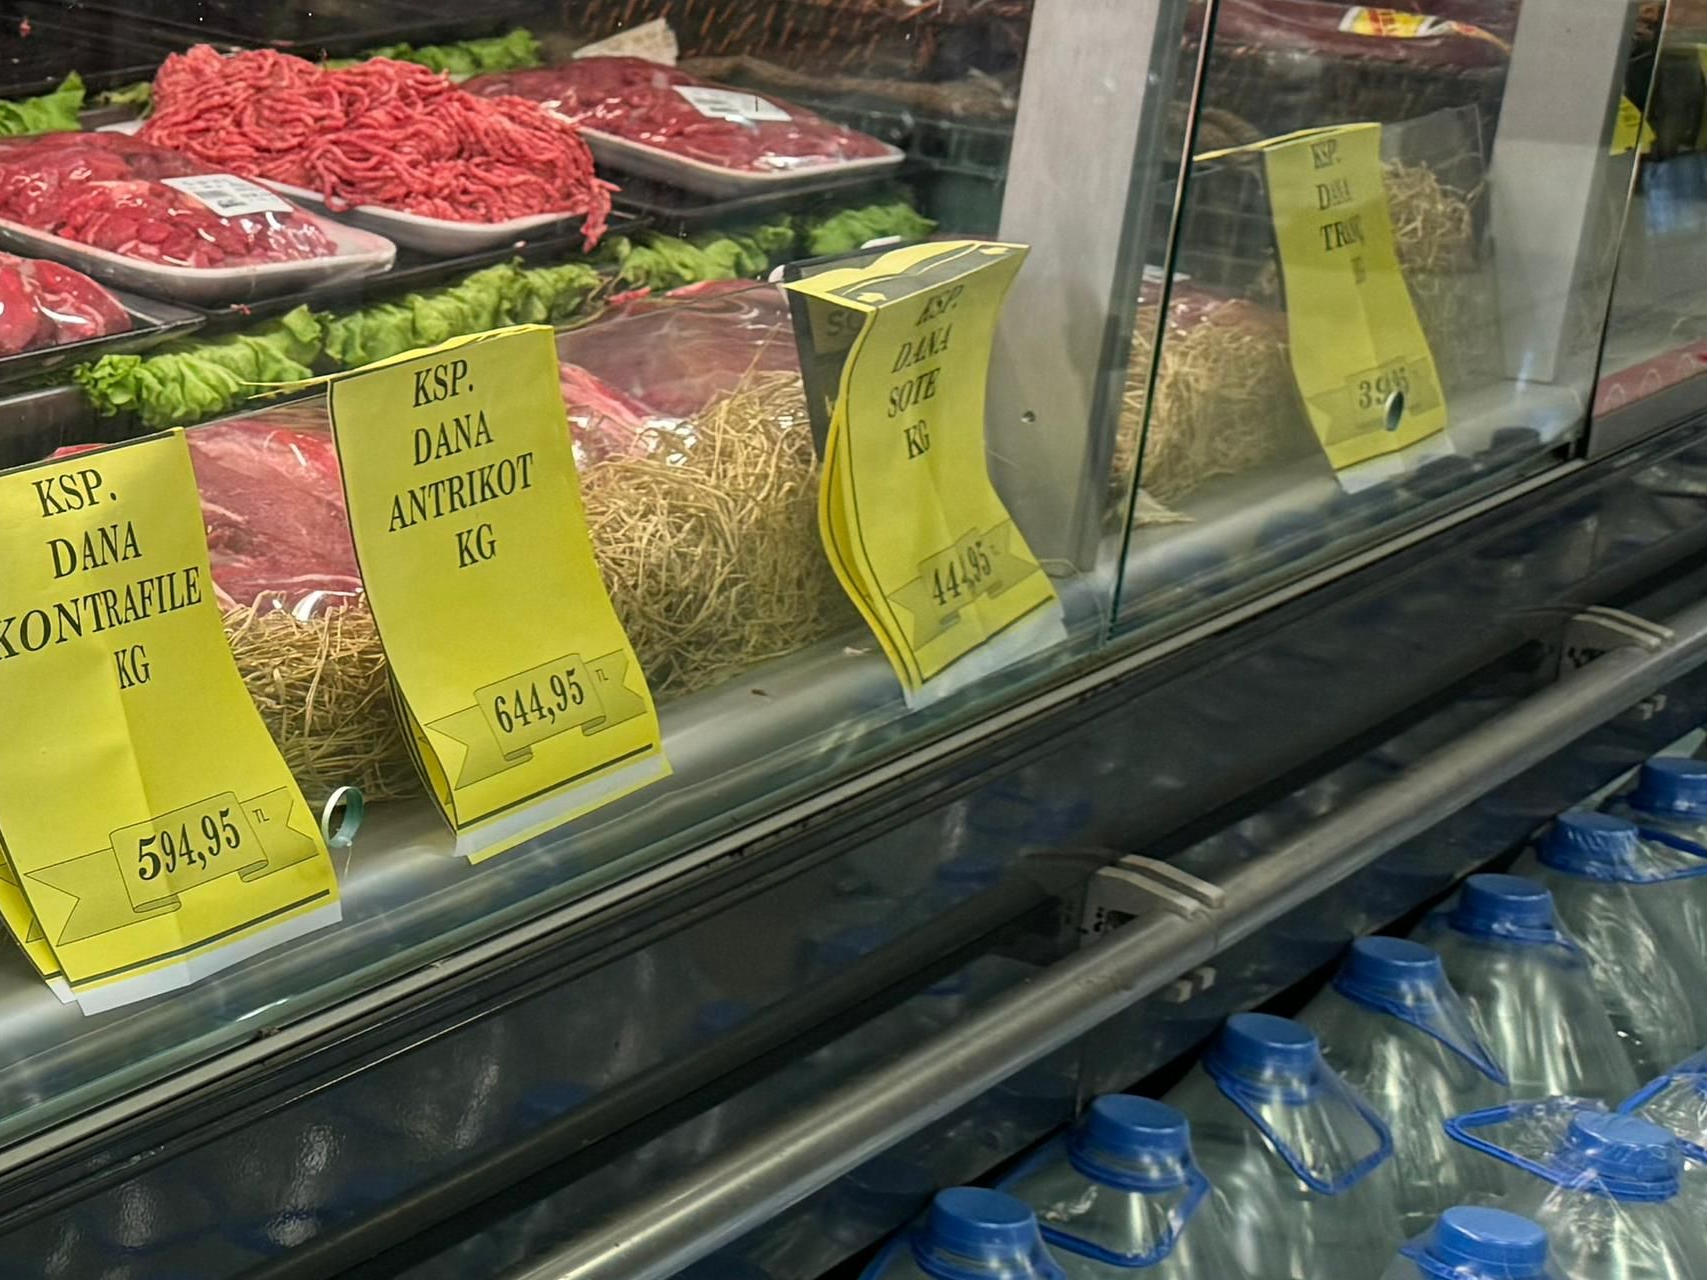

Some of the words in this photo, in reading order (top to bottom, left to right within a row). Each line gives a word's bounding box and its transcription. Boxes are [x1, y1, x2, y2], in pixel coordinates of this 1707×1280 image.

[915, 283, 965, 327] KSP.
[890, 322, 953, 374] DANA
[411, 358, 475, 409] KSP.
[887, 367, 942, 419] SOTE
[412, 408, 495, 466] DANA
[904, 419, 931, 460] KG
[30, 467, 118, 518] KSP.
[387, 451, 534, 535] ANTRIKOT
[47, 520, 143, 580] DANA
[455, 523, 498, 569] KG
[114, 644, 152, 691] KG
[493, 667, 586, 735] 644,95
[252, 807, 271, 824] TL
[137, 807, 242, 882] 594,95
